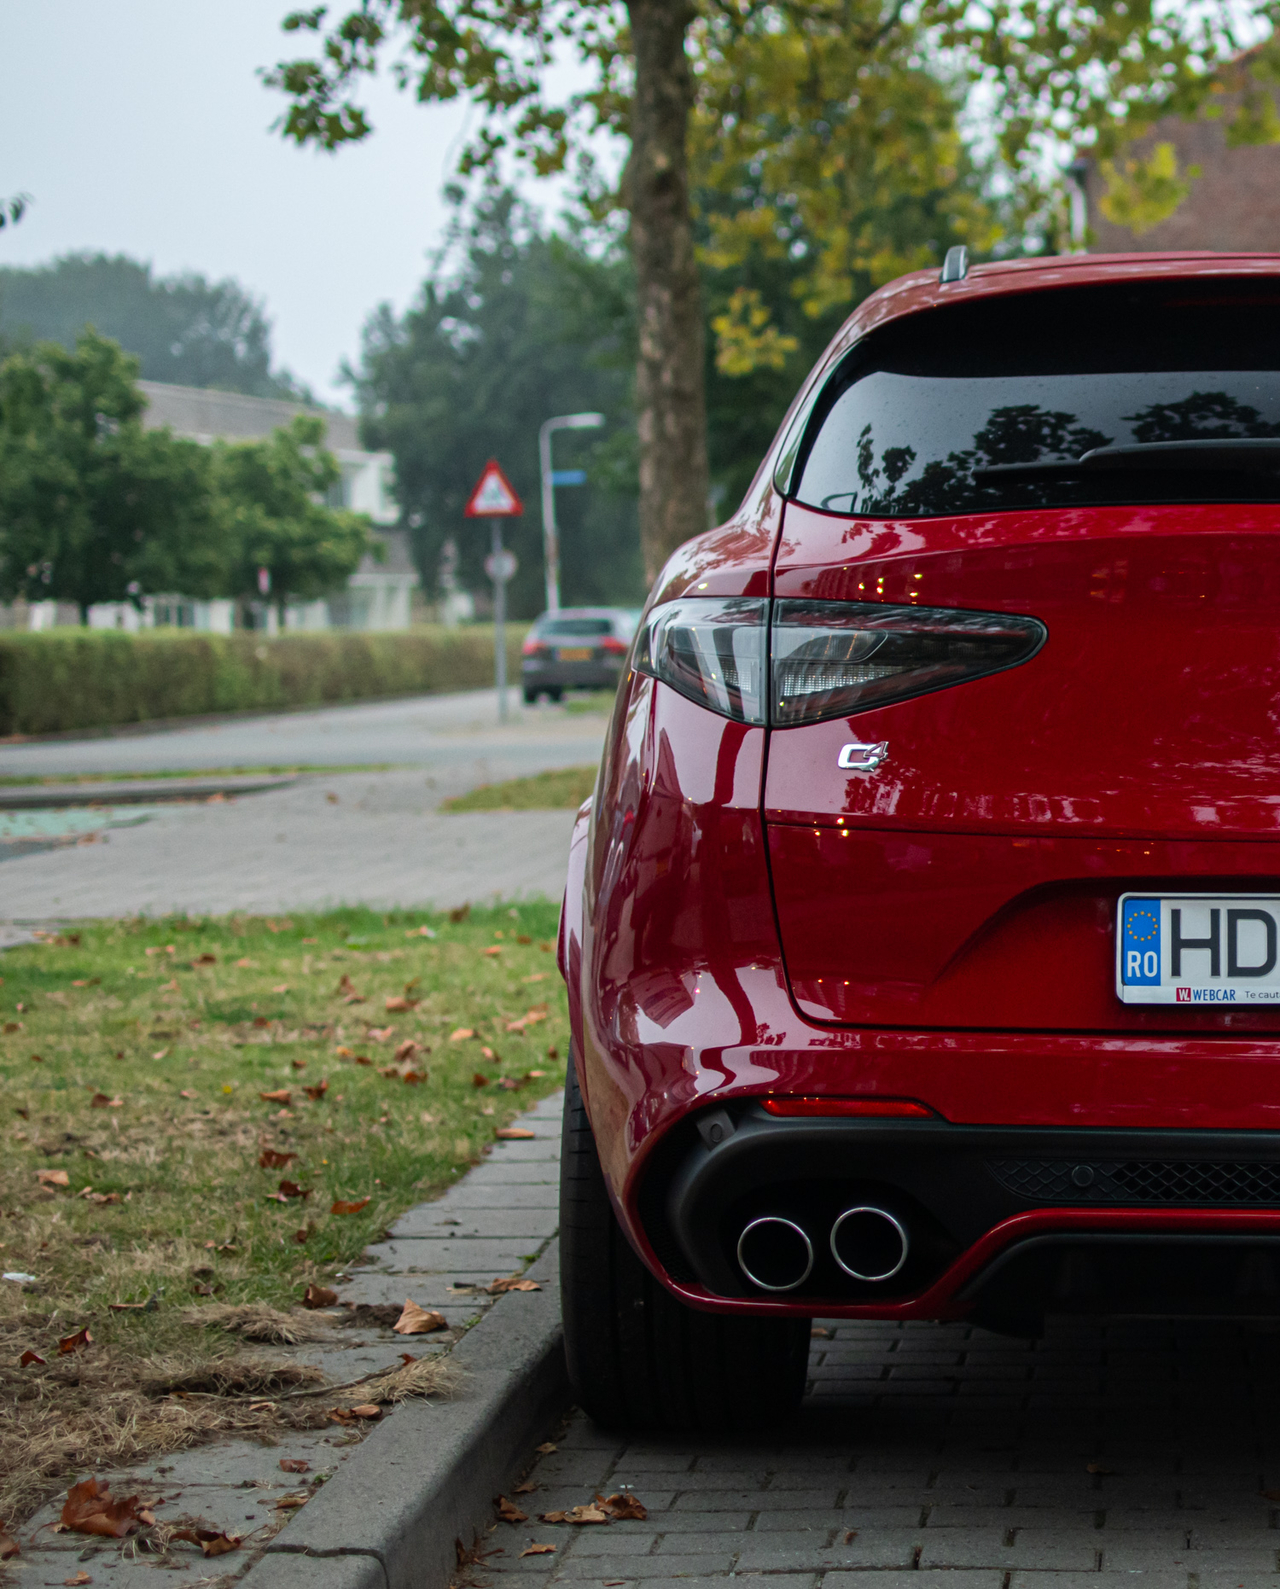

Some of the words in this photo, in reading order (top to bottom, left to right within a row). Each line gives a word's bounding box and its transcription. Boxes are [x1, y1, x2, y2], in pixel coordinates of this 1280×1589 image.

[1170, 908, 1277, 978] HD
[1127, 950, 1158, 978] RO
[1192, 988, 1236, 1001] WEBCAR
[1244, 990, 1256, 999] Te
